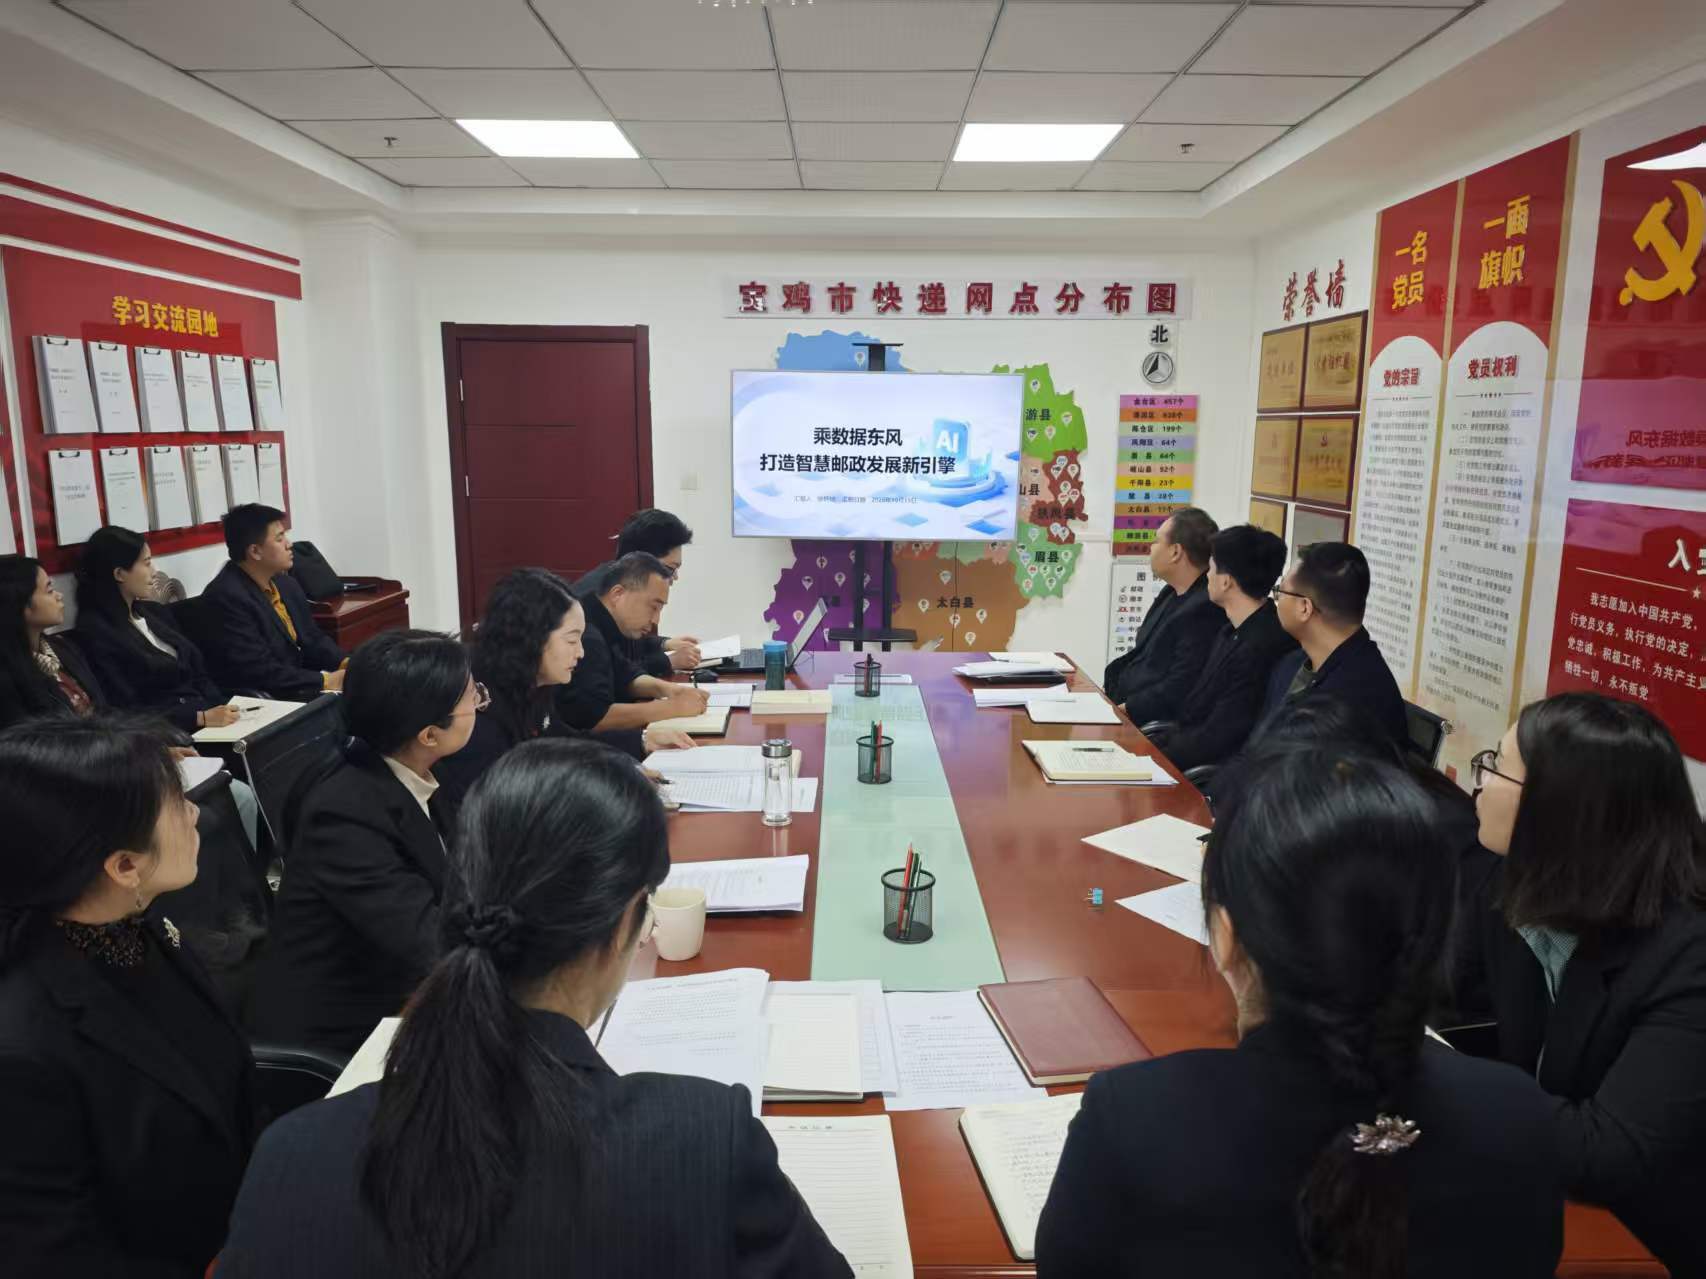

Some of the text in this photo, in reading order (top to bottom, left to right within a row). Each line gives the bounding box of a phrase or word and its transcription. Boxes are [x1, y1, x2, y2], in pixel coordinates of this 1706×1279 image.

[1483, 194, 1530, 239] 一面
[1395, 230, 1428, 265] 一名
[1478, 244, 1525, 289] 旗帜
[739, 281, 1176, 315] 宝鸡市快递网点分布图
[1282, 259, 1346, 321] 荣誉墙
[1391, 271, 1424, 310] 党员
[112, 295, 219, 337] 学习交流园地
[1151, 325, 1168, 343] 北
[1383, 368, 1420, 387] 党的宗旨
[1467, 355, 1518, 380] 党员权利
[813, 427, 903, 447] 乘数据东风
[936, 430, 959, 453] AI
[760, 453, 957, 475] 打造智慧邮政发展新引擎
[1034, 551, 1059, 563] 眉县
[936, 596, 975, 609] 太白县
[1570, 612, 1706, 661] 行党员义务，执行党的决定，
